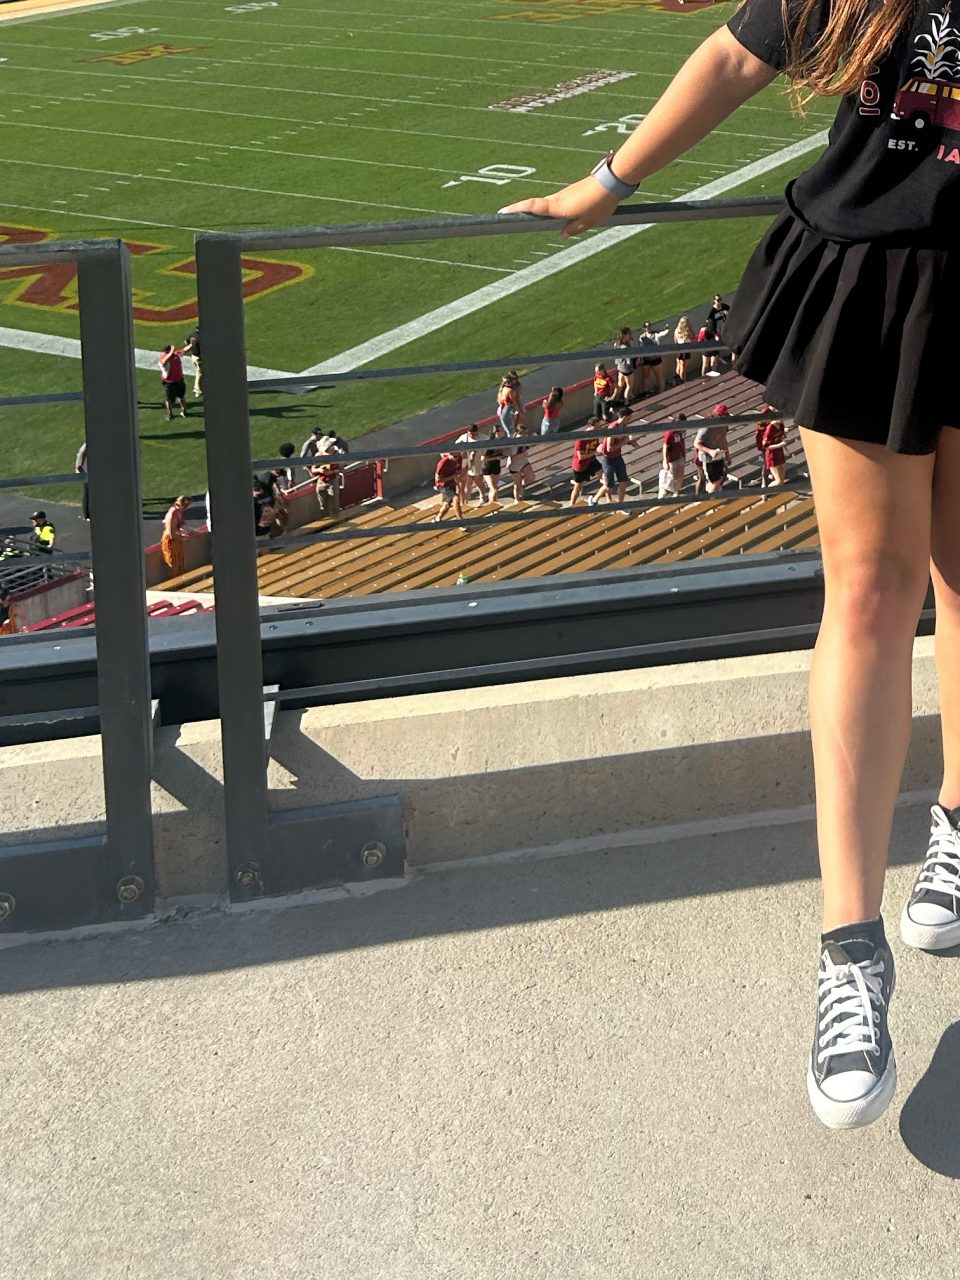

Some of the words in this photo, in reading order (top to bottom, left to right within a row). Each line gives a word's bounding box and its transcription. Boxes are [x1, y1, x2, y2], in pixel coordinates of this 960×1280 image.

[887, 138, 919, 151] EST.
[936, 144, 960, 165] IA
[459, 164, 537, 185] 10
